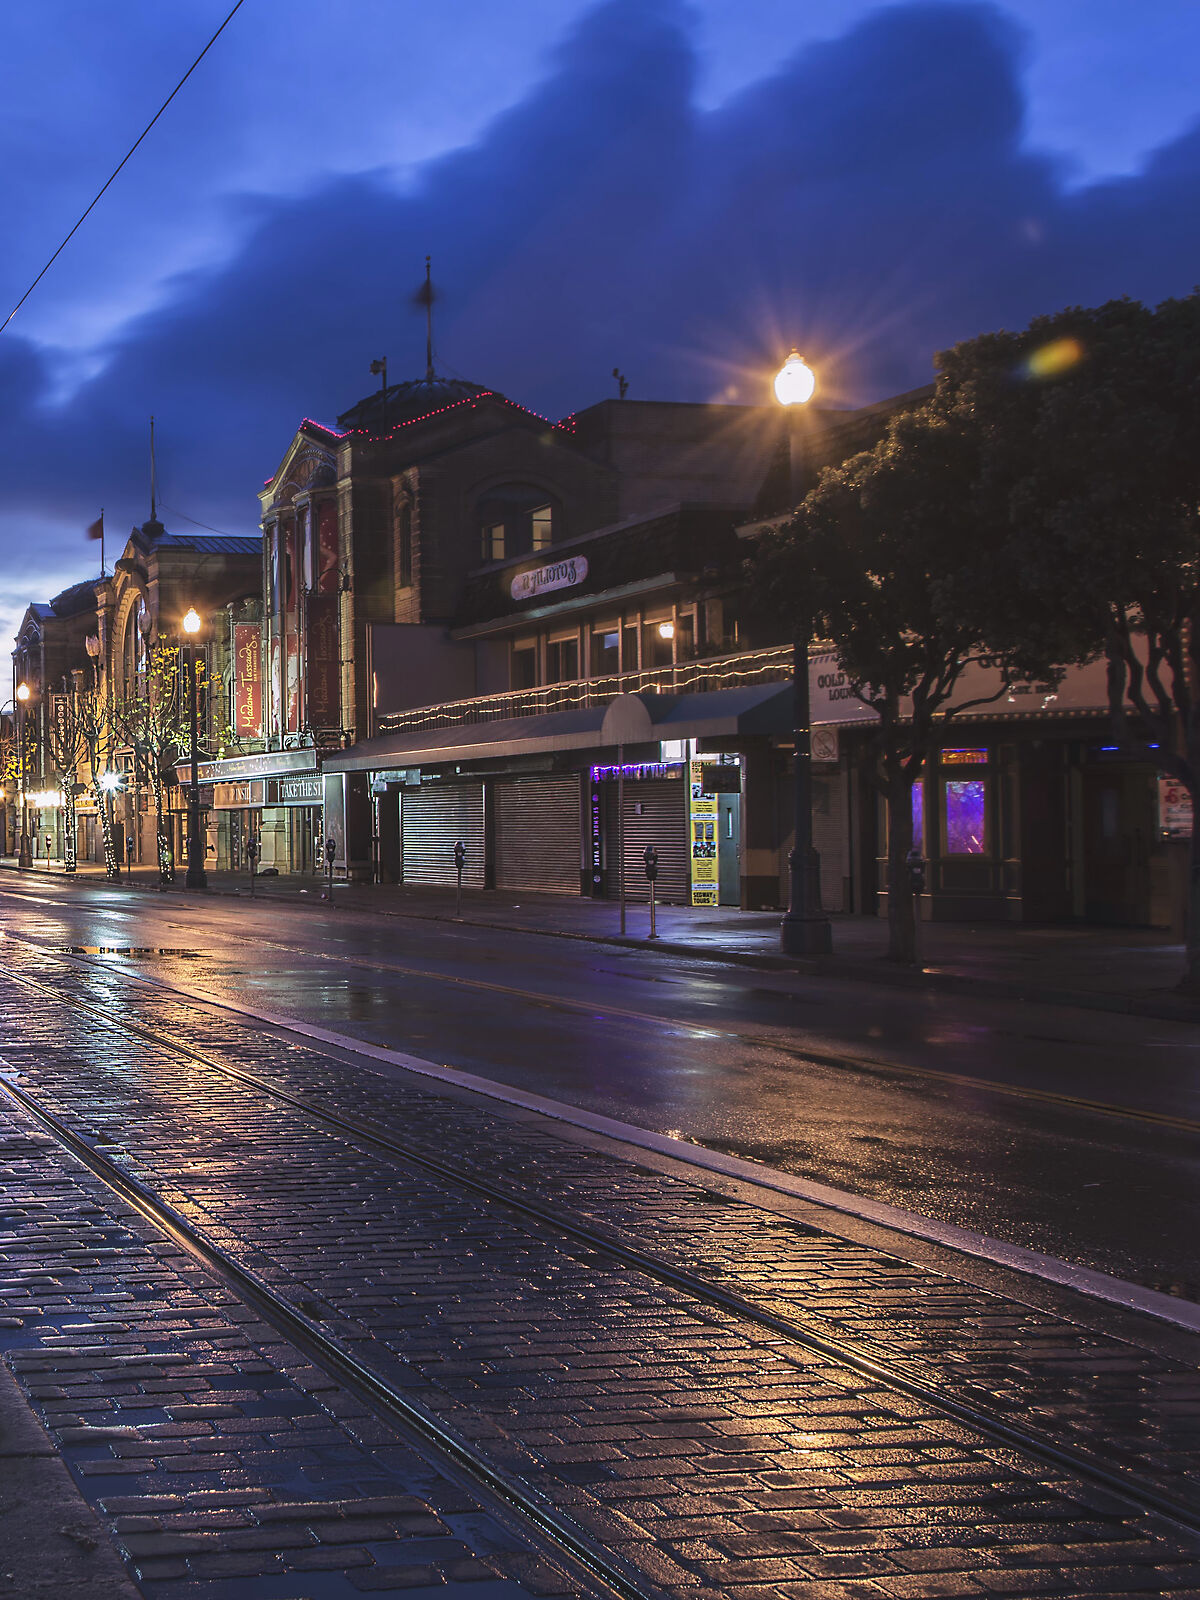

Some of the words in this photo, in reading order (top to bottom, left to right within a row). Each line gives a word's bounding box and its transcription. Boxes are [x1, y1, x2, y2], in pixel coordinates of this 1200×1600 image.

[239, 640, 258, 687] Tussauds
[818, 672, 844, 688] GOLD
[240, 684, 255, 727] Madame
[280, 783, 298, 798] TAKE
[296, 782, 312, 797] THE
[313, 781, 323, 796] ST
[593, 850, 601, 867] VAPE
